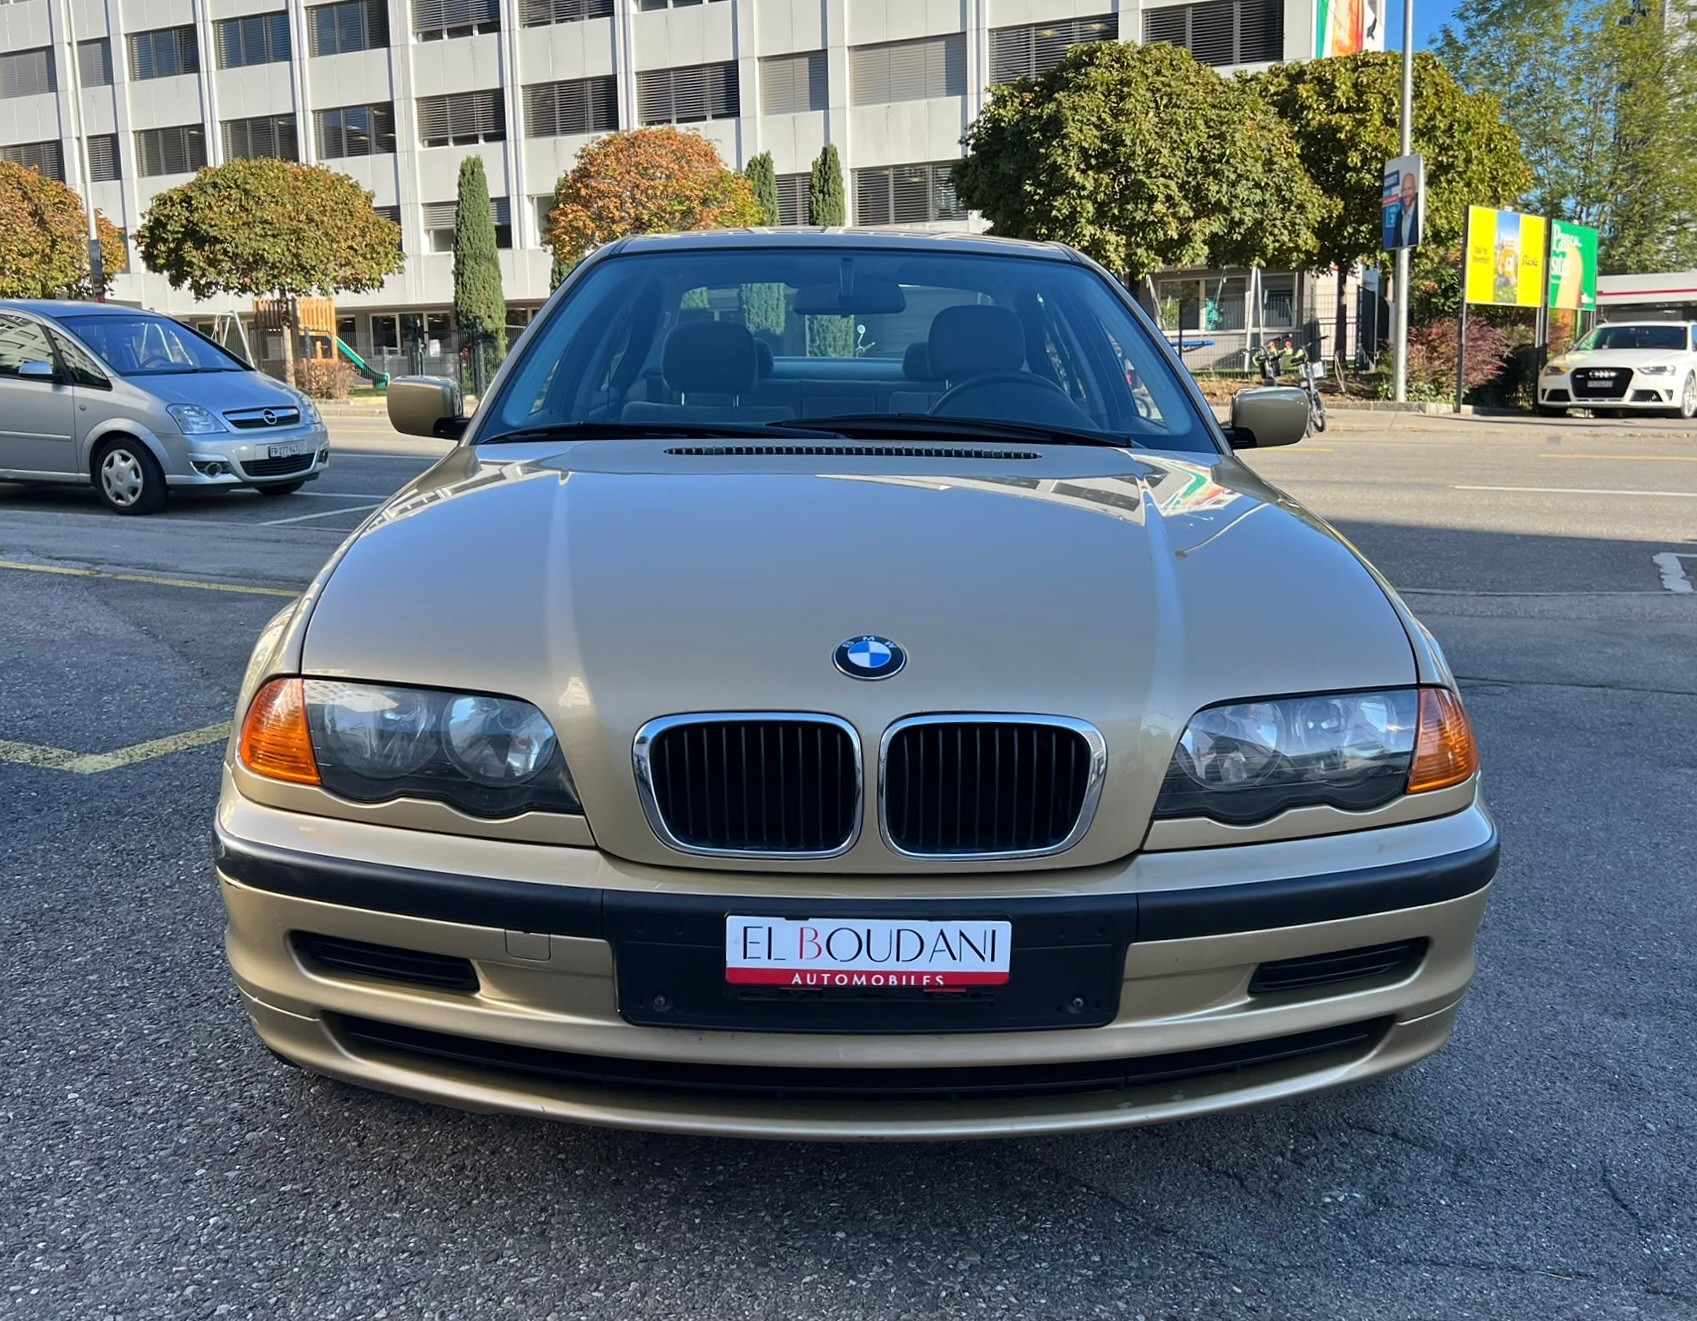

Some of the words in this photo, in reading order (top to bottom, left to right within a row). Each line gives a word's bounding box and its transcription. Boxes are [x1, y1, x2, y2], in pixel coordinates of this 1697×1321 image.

[842, 636, 897, 648] BMW
[743, 926, 786, 961] EL
[799, 926, 996, 963] BOUDANI
[791, 973, 944, 986] AUTOMOBILES
